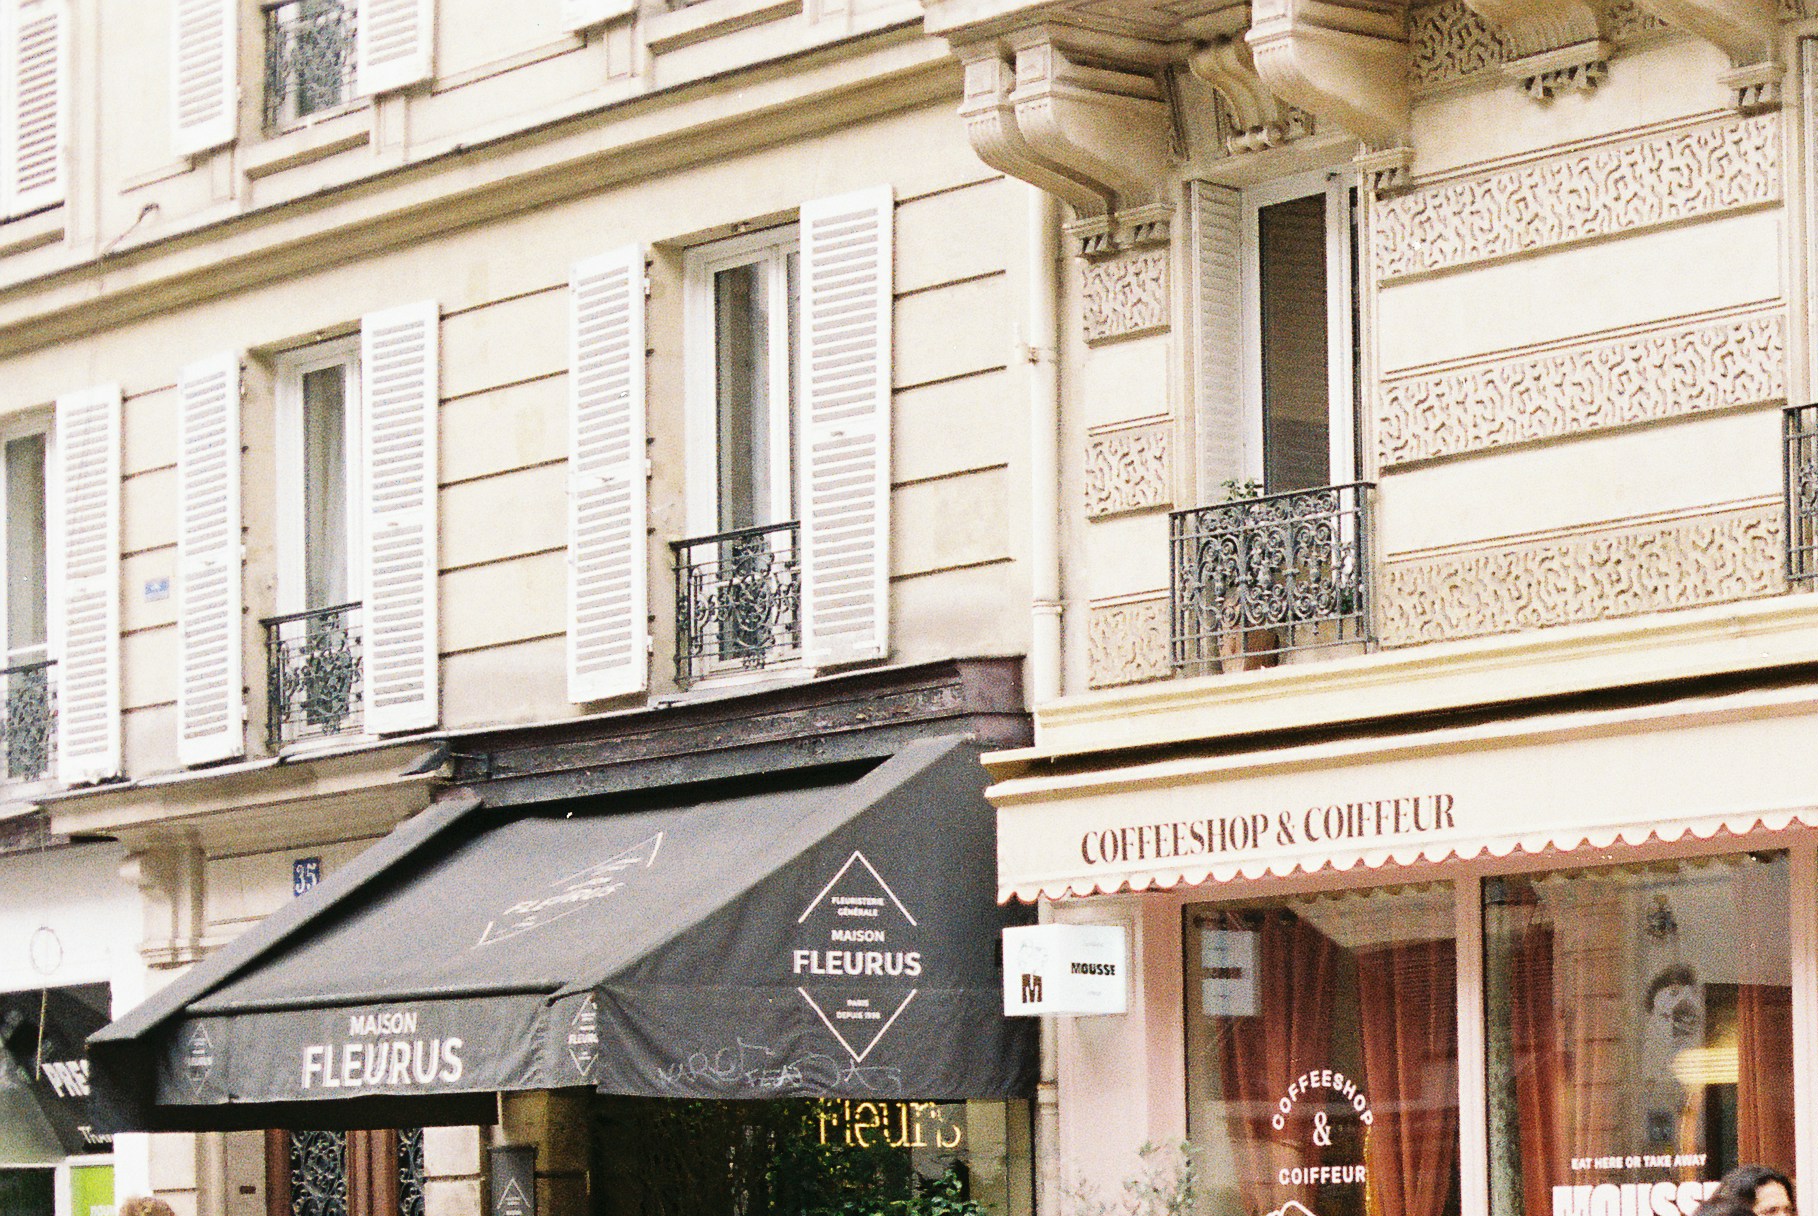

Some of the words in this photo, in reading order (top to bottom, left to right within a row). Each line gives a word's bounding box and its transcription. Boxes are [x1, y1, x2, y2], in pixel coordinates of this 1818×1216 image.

[1081, 812, 1269, 865] COFFEESHOP
[1276, 810, 1296, 846] &
[1304, 793, 1455, 843] COIFFEUR
[295, 862, 318, 894] 35
[831, 930, 885, 942] MAISON
[793, 950, 922, 976] FLEURUS
[1070, 962, 1116, 976] MOUSSE
[350, 1012, 418, 1037] MAISON
[302, 1036, 464, 1090] FLEURUS
[1272, 1070, 1374, 1131] COFFEESHOP
[1312, 1111, 1333, 1147] &
[1571, 1157, 1592, 1170] EAT
[1594, 1156, 1624, 1169] HERE
[1625, 1155, 1642, 1168] OR
[1643, 1154, 1672, 1168] TAKE
[1673, 1153, 1707, 1167] AWAY
[1278, 1165, 1366, 1185] COIFFEUR
